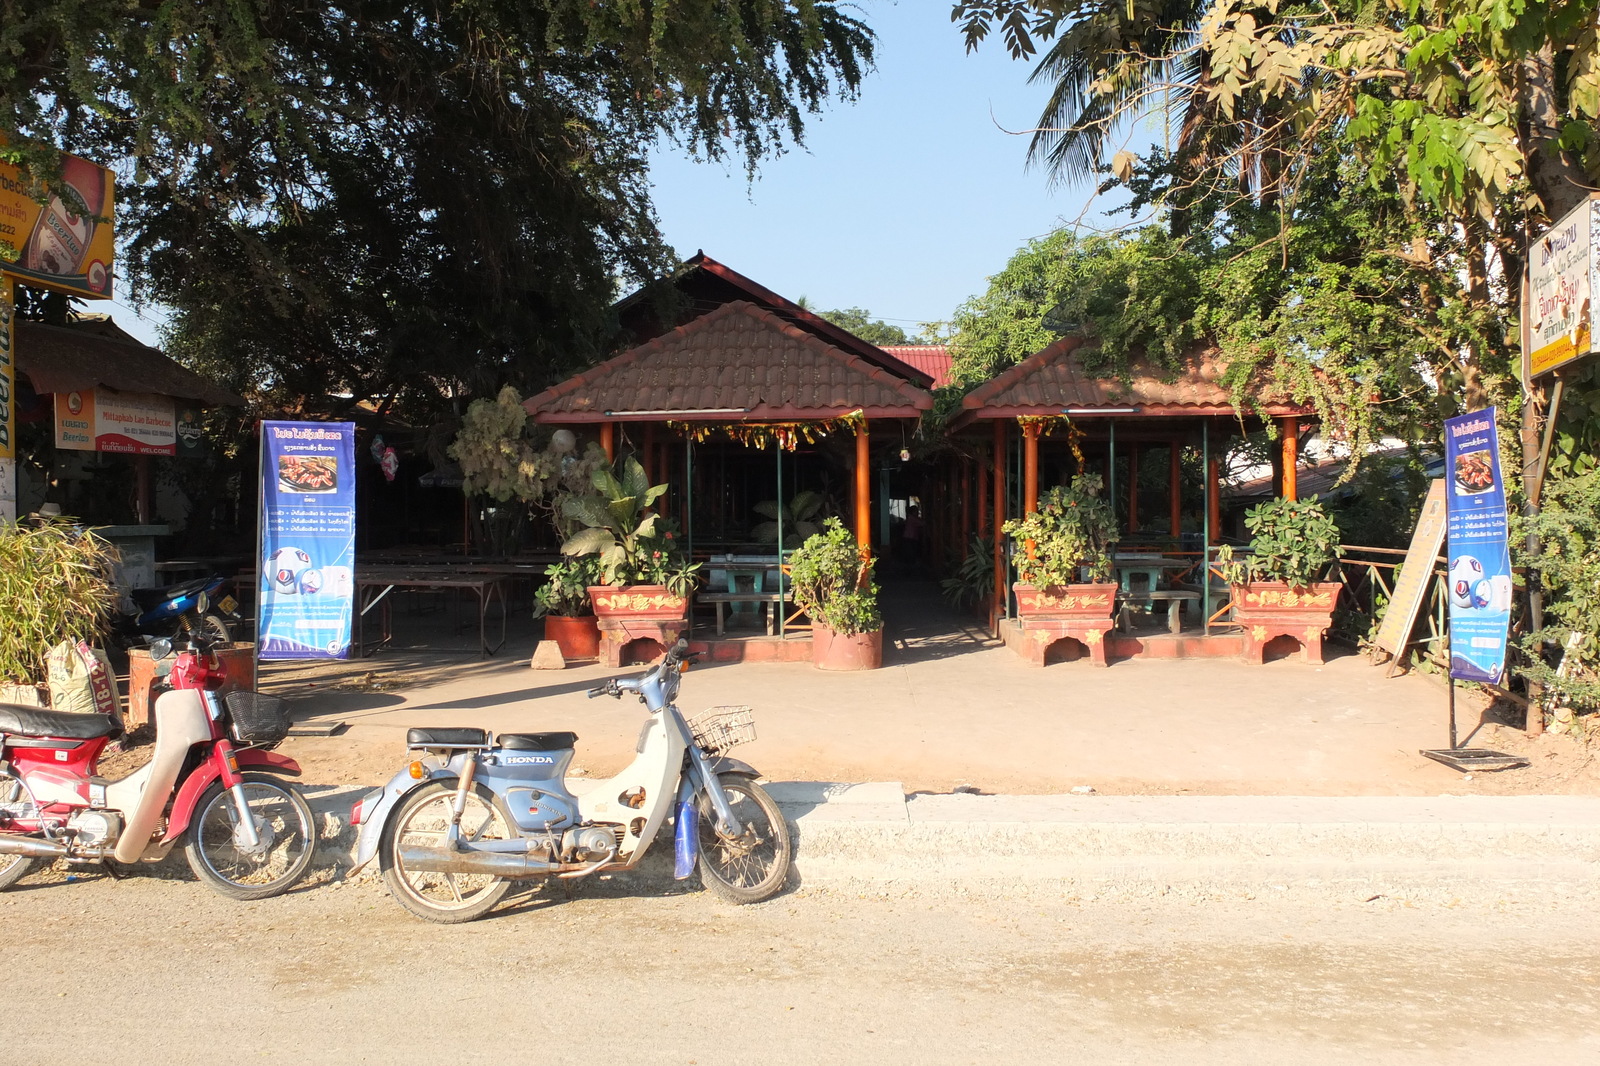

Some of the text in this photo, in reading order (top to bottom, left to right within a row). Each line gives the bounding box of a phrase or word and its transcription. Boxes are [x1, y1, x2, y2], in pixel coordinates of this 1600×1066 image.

[47, 213, 80, 255] Beerlao
[103, 412, 171, 427] Mittaphab Lao Barbecue
[63, 432, 89, 443] Beerlao
